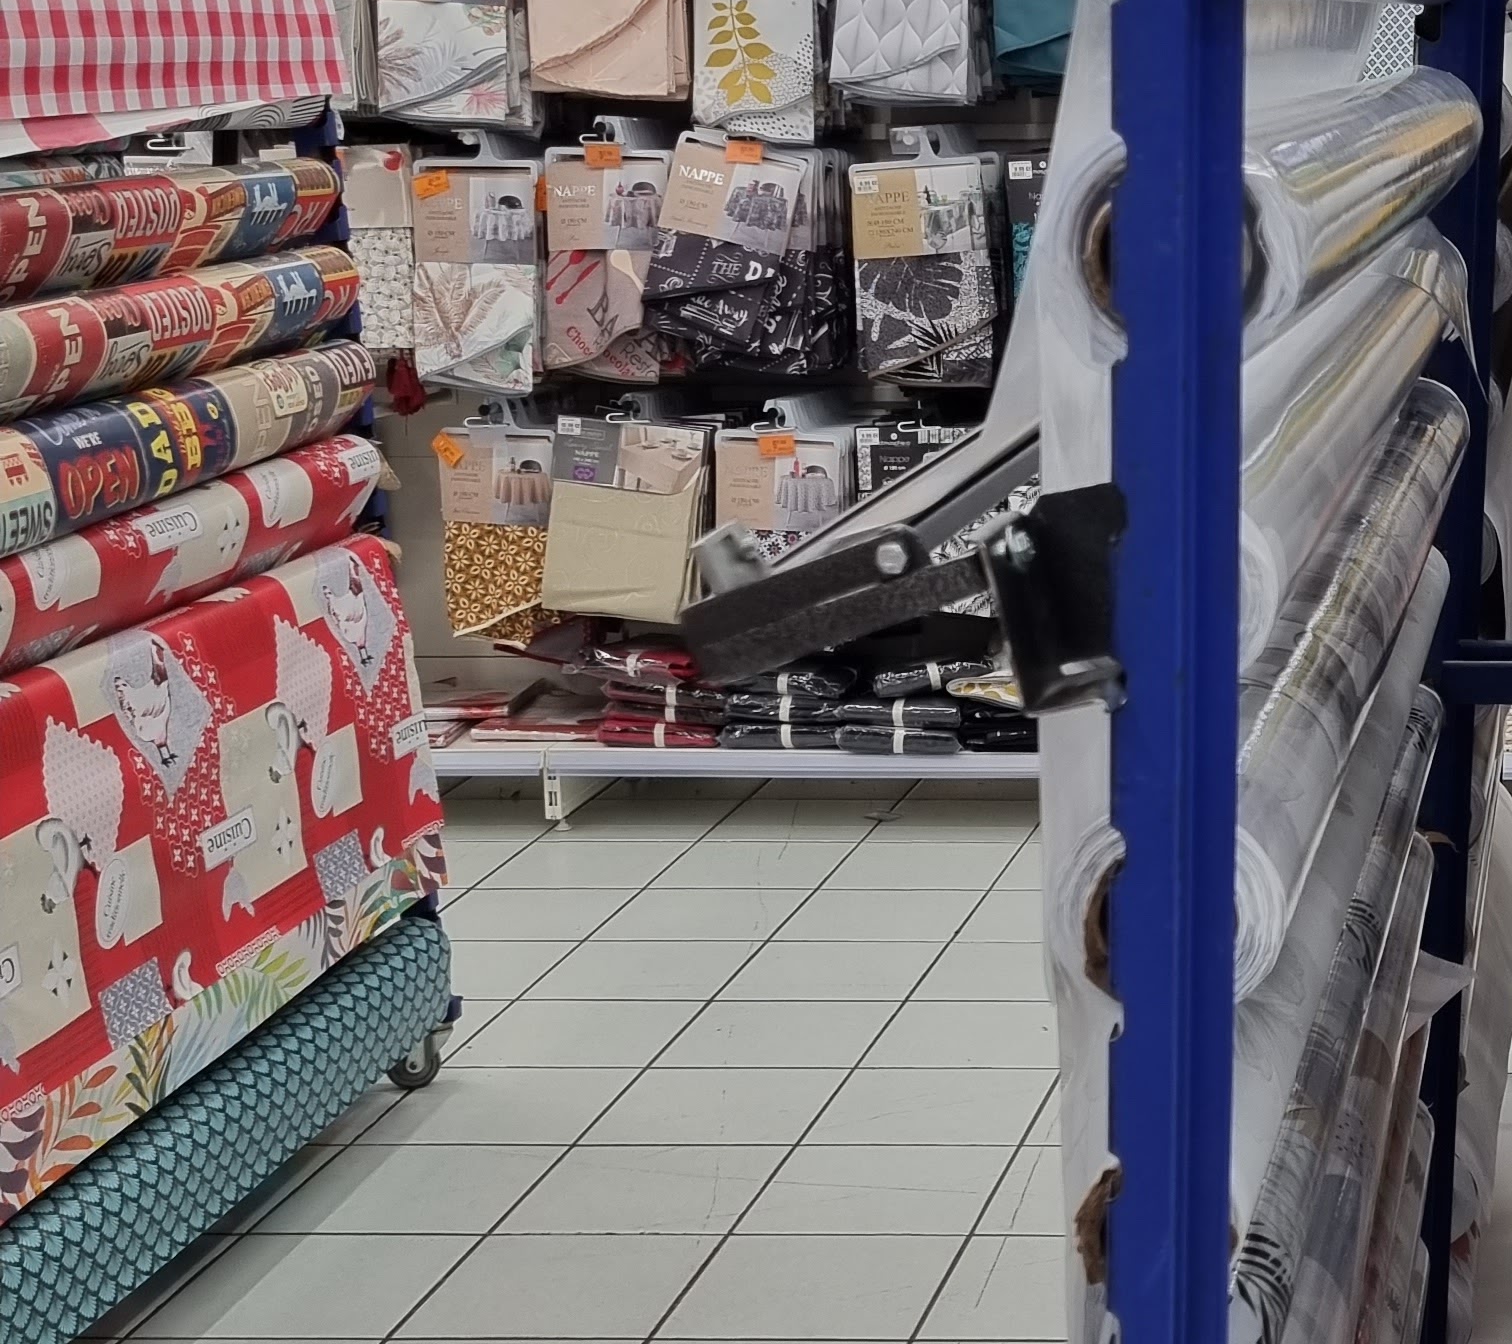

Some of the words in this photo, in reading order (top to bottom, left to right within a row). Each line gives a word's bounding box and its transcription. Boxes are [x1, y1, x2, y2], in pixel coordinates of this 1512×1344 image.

[679, 165, 725, 185] NAPPE
[553, 185, 596, 197] NAPPE
[56, 235, 112, 277] Sorry
[711, 260, 743, 276] THE
[101, 340, 151, 380] Sorry
[305, 365, 323, 433] OSED
[126, 401, 178, 498] DAD
[348, 449, 378, 470] uisine
[879, 455, 911, 465] Nappe
[59, 444, 141, 520] OPEN
[146, 510, 199, 538] Cuisine
[396, 718, 428, 744] uisine
[207, 816, 252, 854] Cuisine
